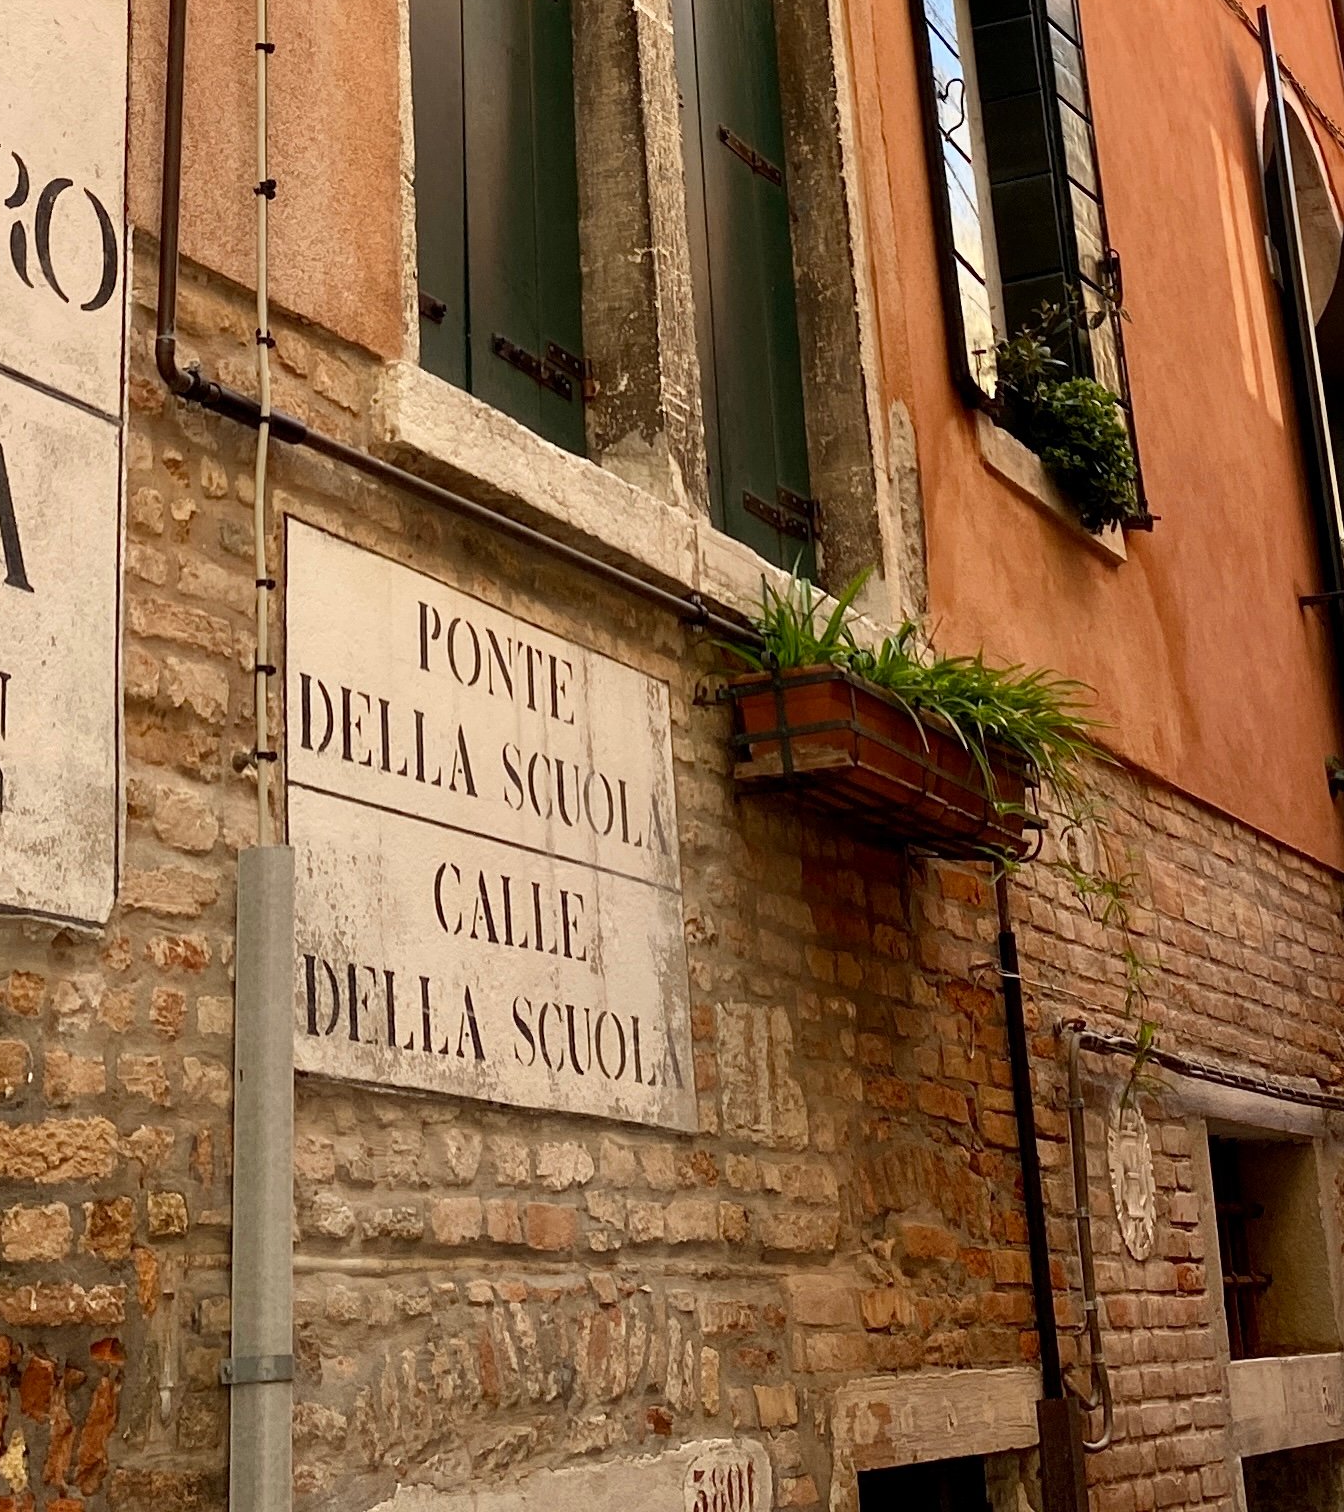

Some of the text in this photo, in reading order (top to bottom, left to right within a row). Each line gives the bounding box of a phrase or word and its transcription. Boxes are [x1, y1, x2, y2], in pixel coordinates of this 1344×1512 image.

[418, 601, 575, 725] PONTE
[300, 673, 670, 856] DELLA SCUOLA
[435, 862, 587, 961] CALLE
[304, 954, 684, 1088] DELLA SCUOLA
